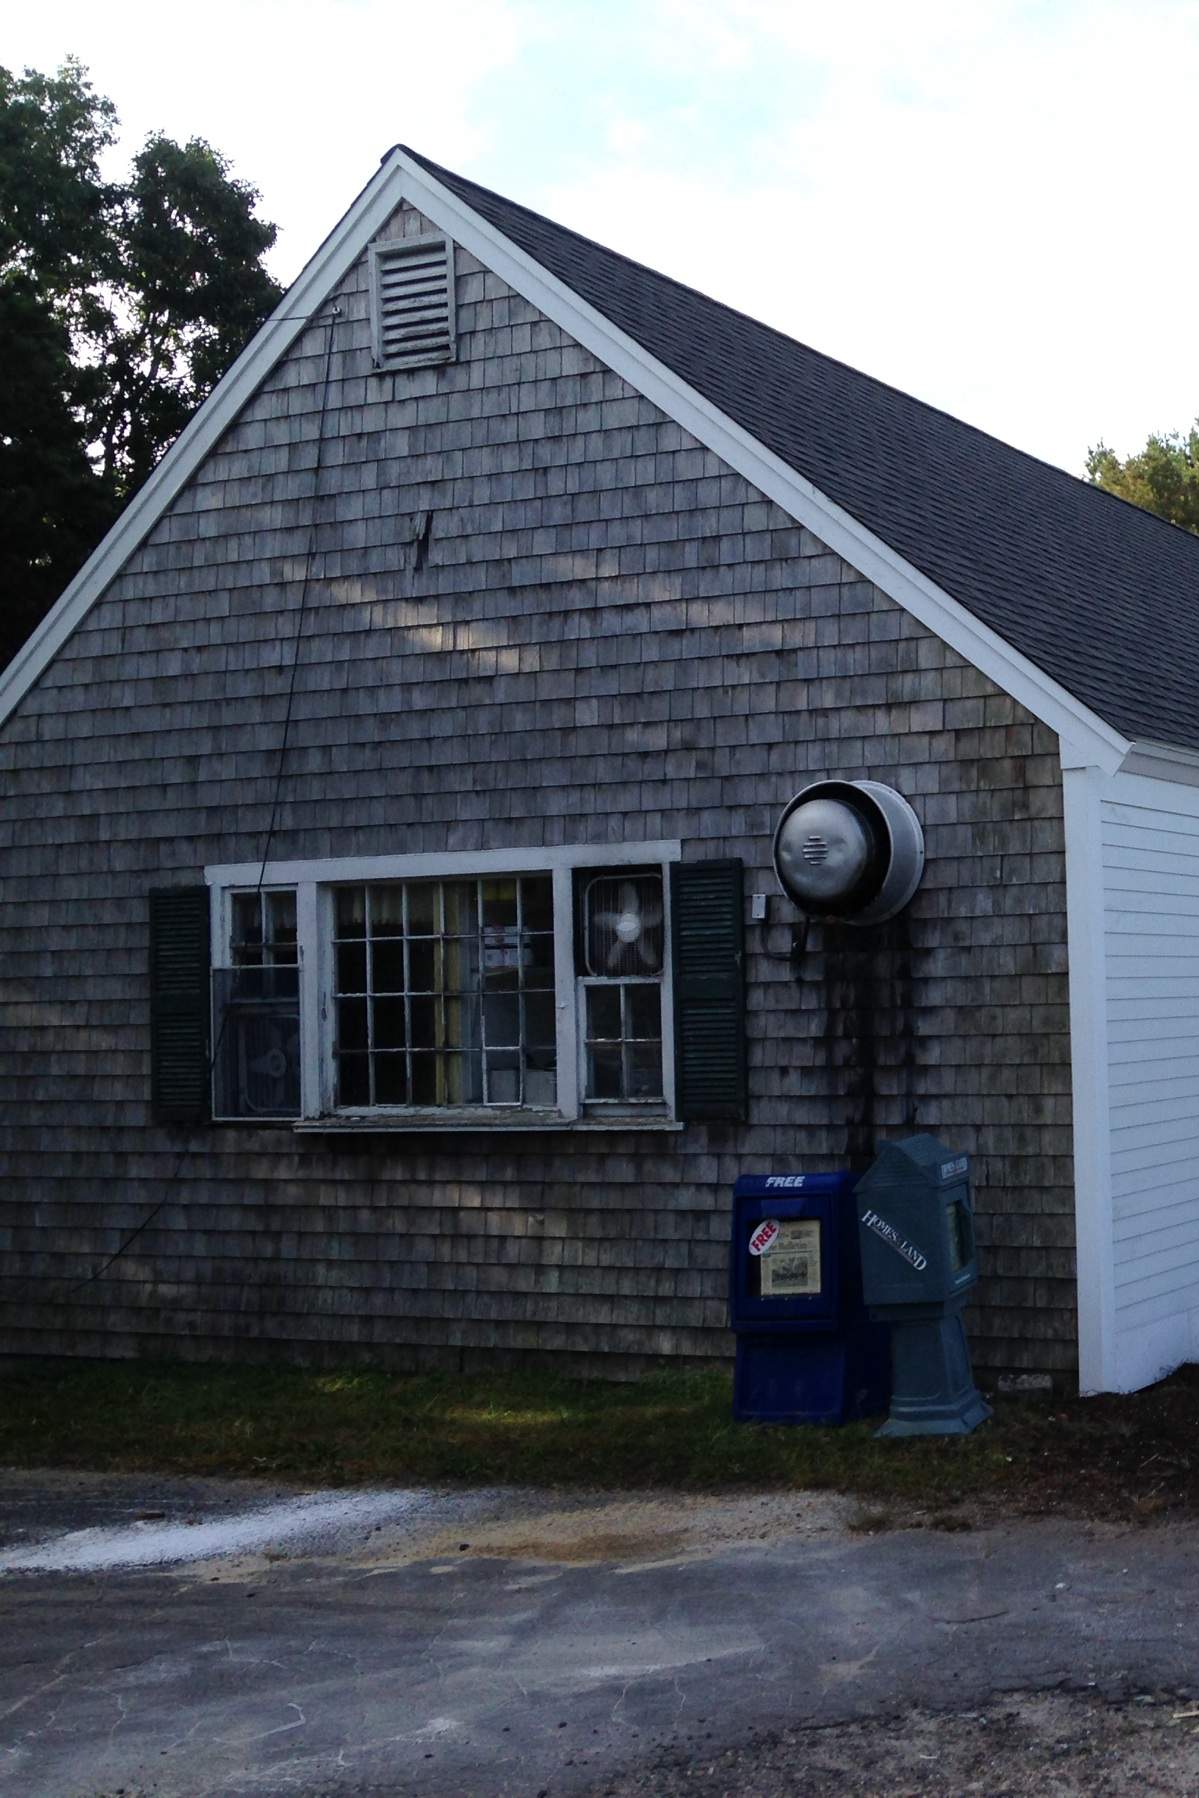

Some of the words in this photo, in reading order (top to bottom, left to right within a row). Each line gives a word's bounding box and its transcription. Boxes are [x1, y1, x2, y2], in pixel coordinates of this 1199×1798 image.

[765, 1176, 806, 1188] FREE
[751, 1221, 777, 1252] FREE
[899, 1240, 928, 1271] LAND
